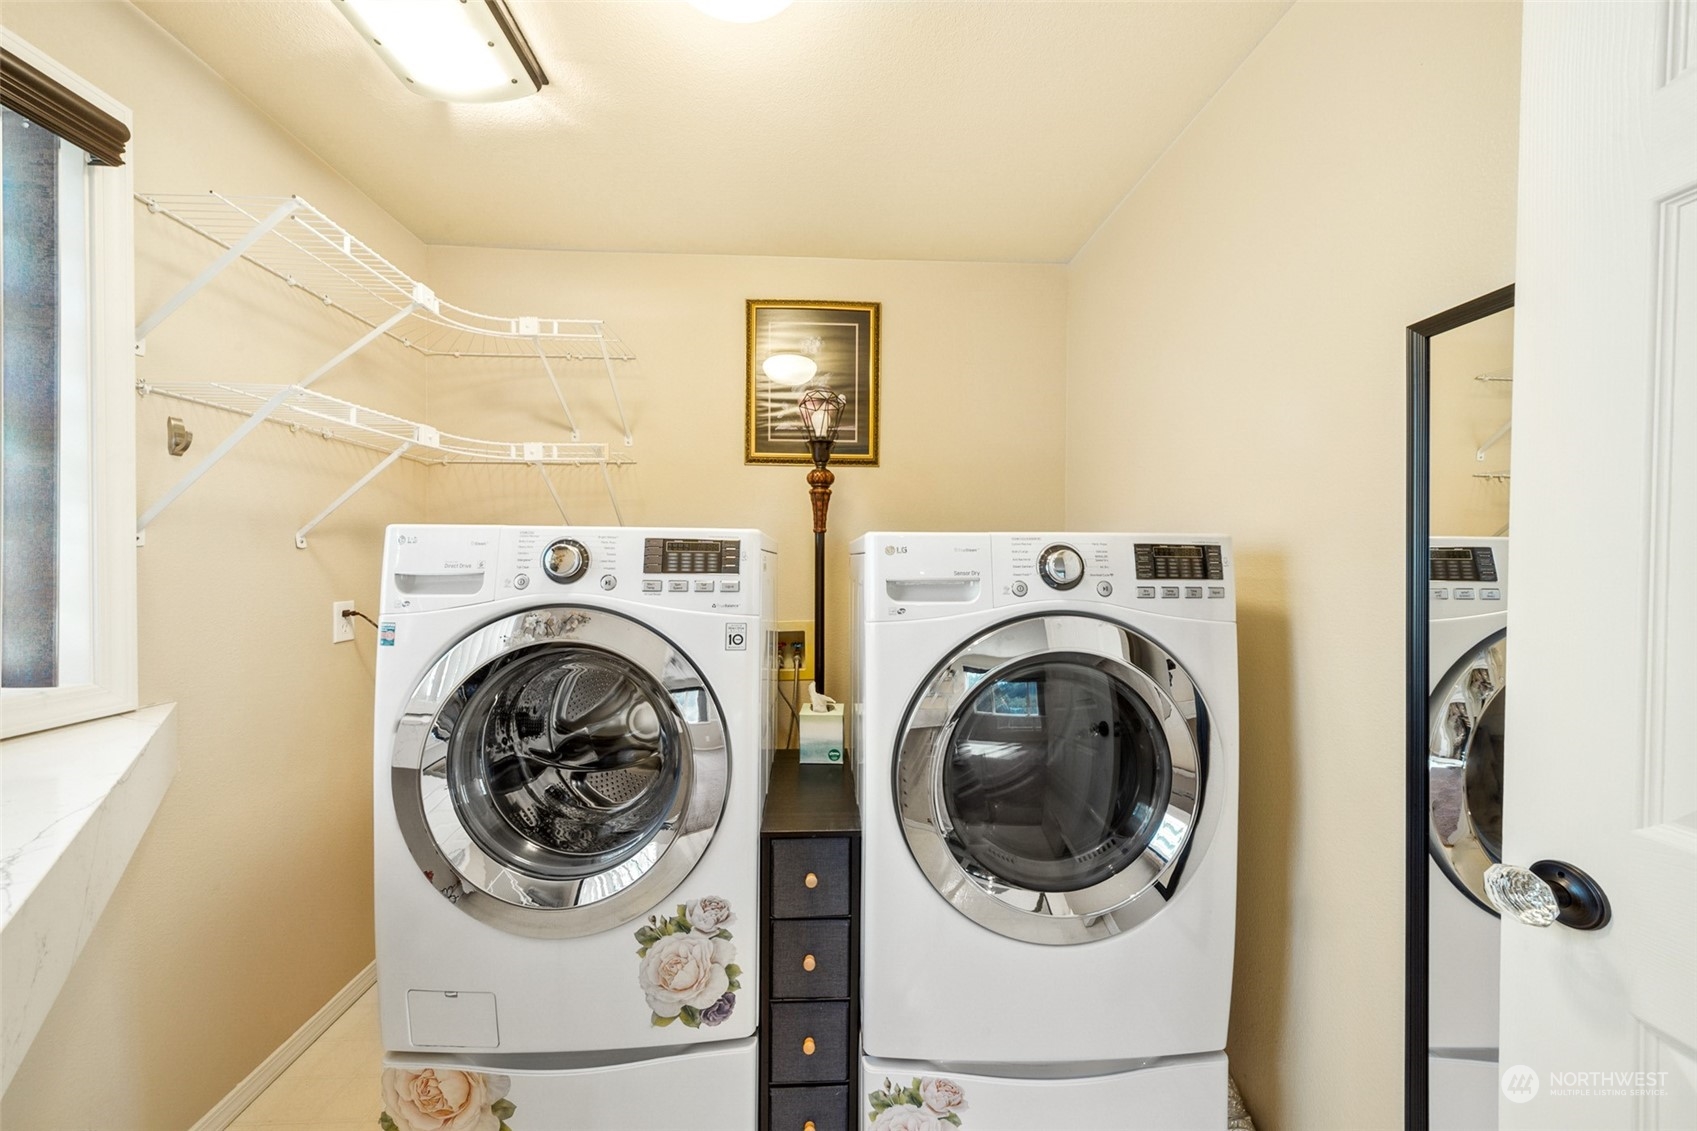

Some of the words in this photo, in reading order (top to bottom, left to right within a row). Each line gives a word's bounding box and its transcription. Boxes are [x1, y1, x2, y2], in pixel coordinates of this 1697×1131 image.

[896, 546, 908, 554] LG
[953, 569, 970, 577] Sensor
[728, 633, 744, 646] 10
